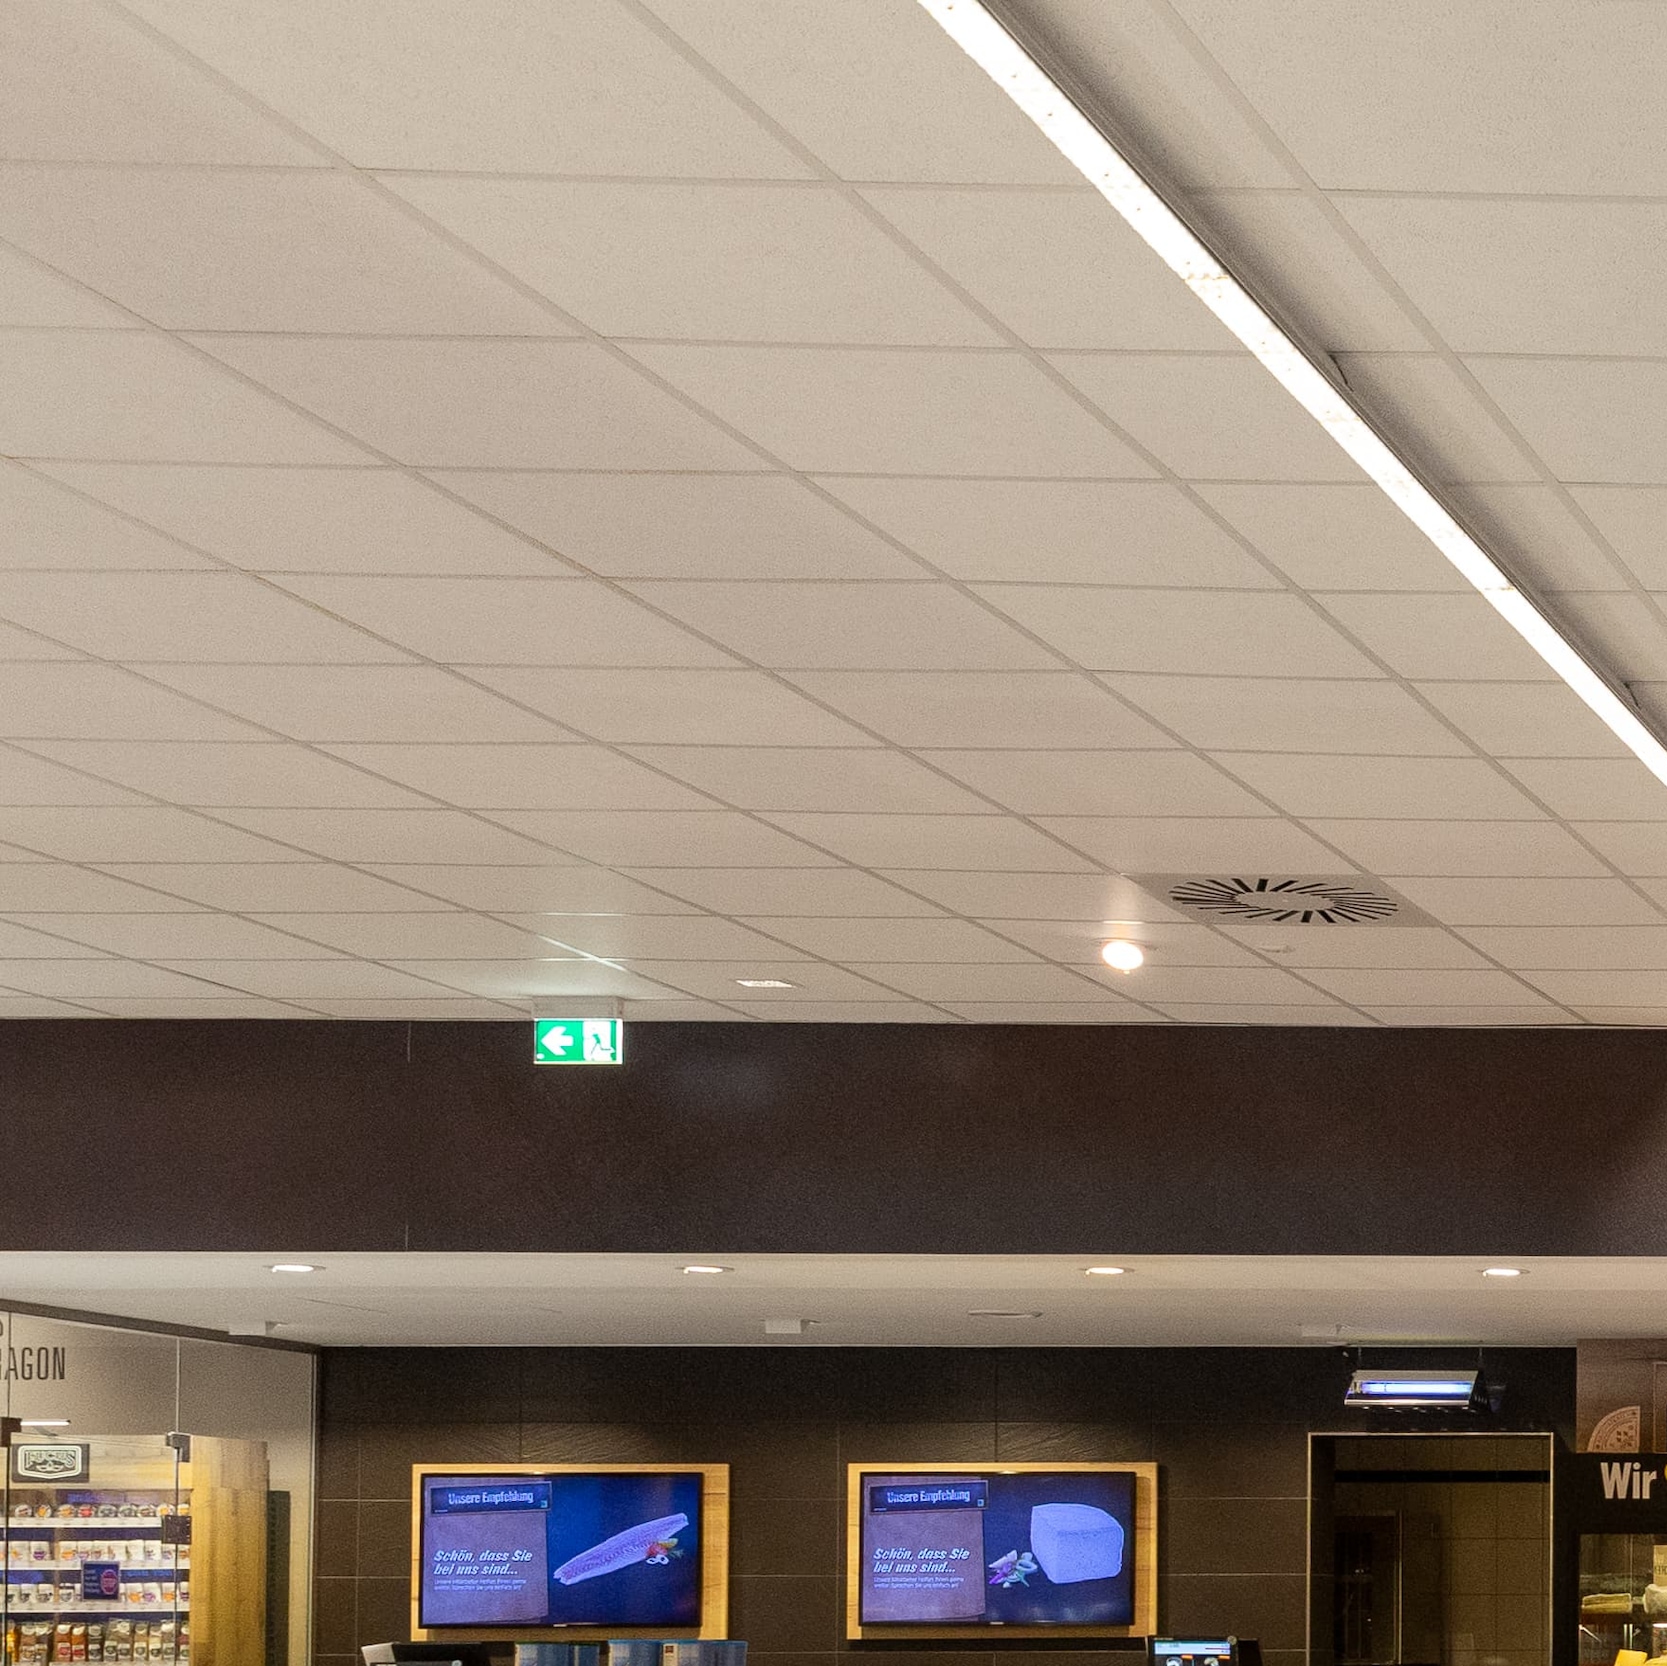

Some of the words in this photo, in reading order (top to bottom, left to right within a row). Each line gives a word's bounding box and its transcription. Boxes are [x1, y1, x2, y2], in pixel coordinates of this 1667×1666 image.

[1600, 1462, 1657, 1499] Wir
[448, 1492, 480, 1505] Unsere
[482, 1490, 534, 1505] Empfehlung
[887, 1491, 919, 1504] Unsere
[920, 1489, 971, 1504] Empfehlung
[434, 1550, 476, 1563] Schön,
[479, 1550, 508, 1562] dass
[511, 1550, 533, 1562] Sie
[873, 1548, 913, 1562] Schön,
[918, 1548, 948, 1560] dass
[950, 1548, 970, 1560] Sie
[433, 1563, 455, 1576] bei
[457, 1564, 479, 1576] uns
[481, 1563, 518, 1576] sind...
[873, 1561, 893, 1574] bei
[895, 1562, 917, 1574] uns
[919, 1561, 956, 1574] sind...
